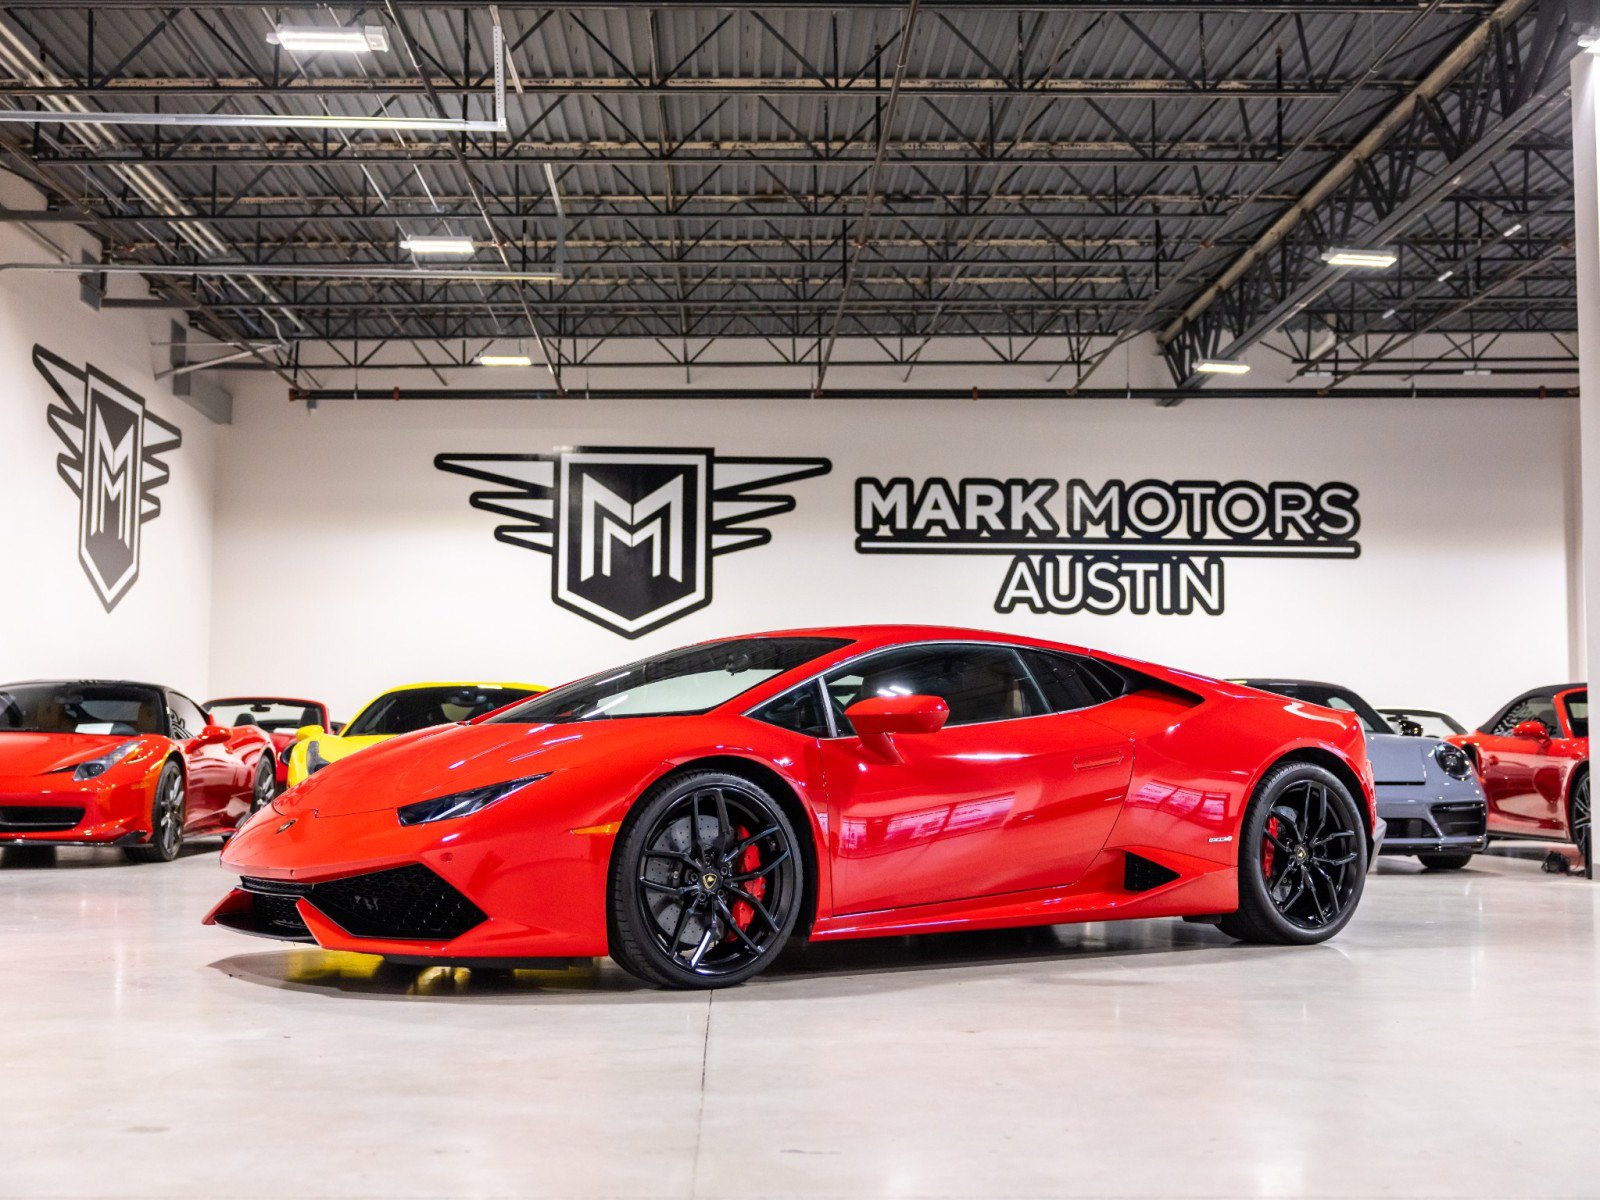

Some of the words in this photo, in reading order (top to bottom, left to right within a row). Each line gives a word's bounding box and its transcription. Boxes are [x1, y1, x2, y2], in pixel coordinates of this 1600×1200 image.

[859, 481, 1055, 533] MARK
[1071, 484, 1356, 537] MOTORS
[998, 560, 1221, 612] AUSTIN
